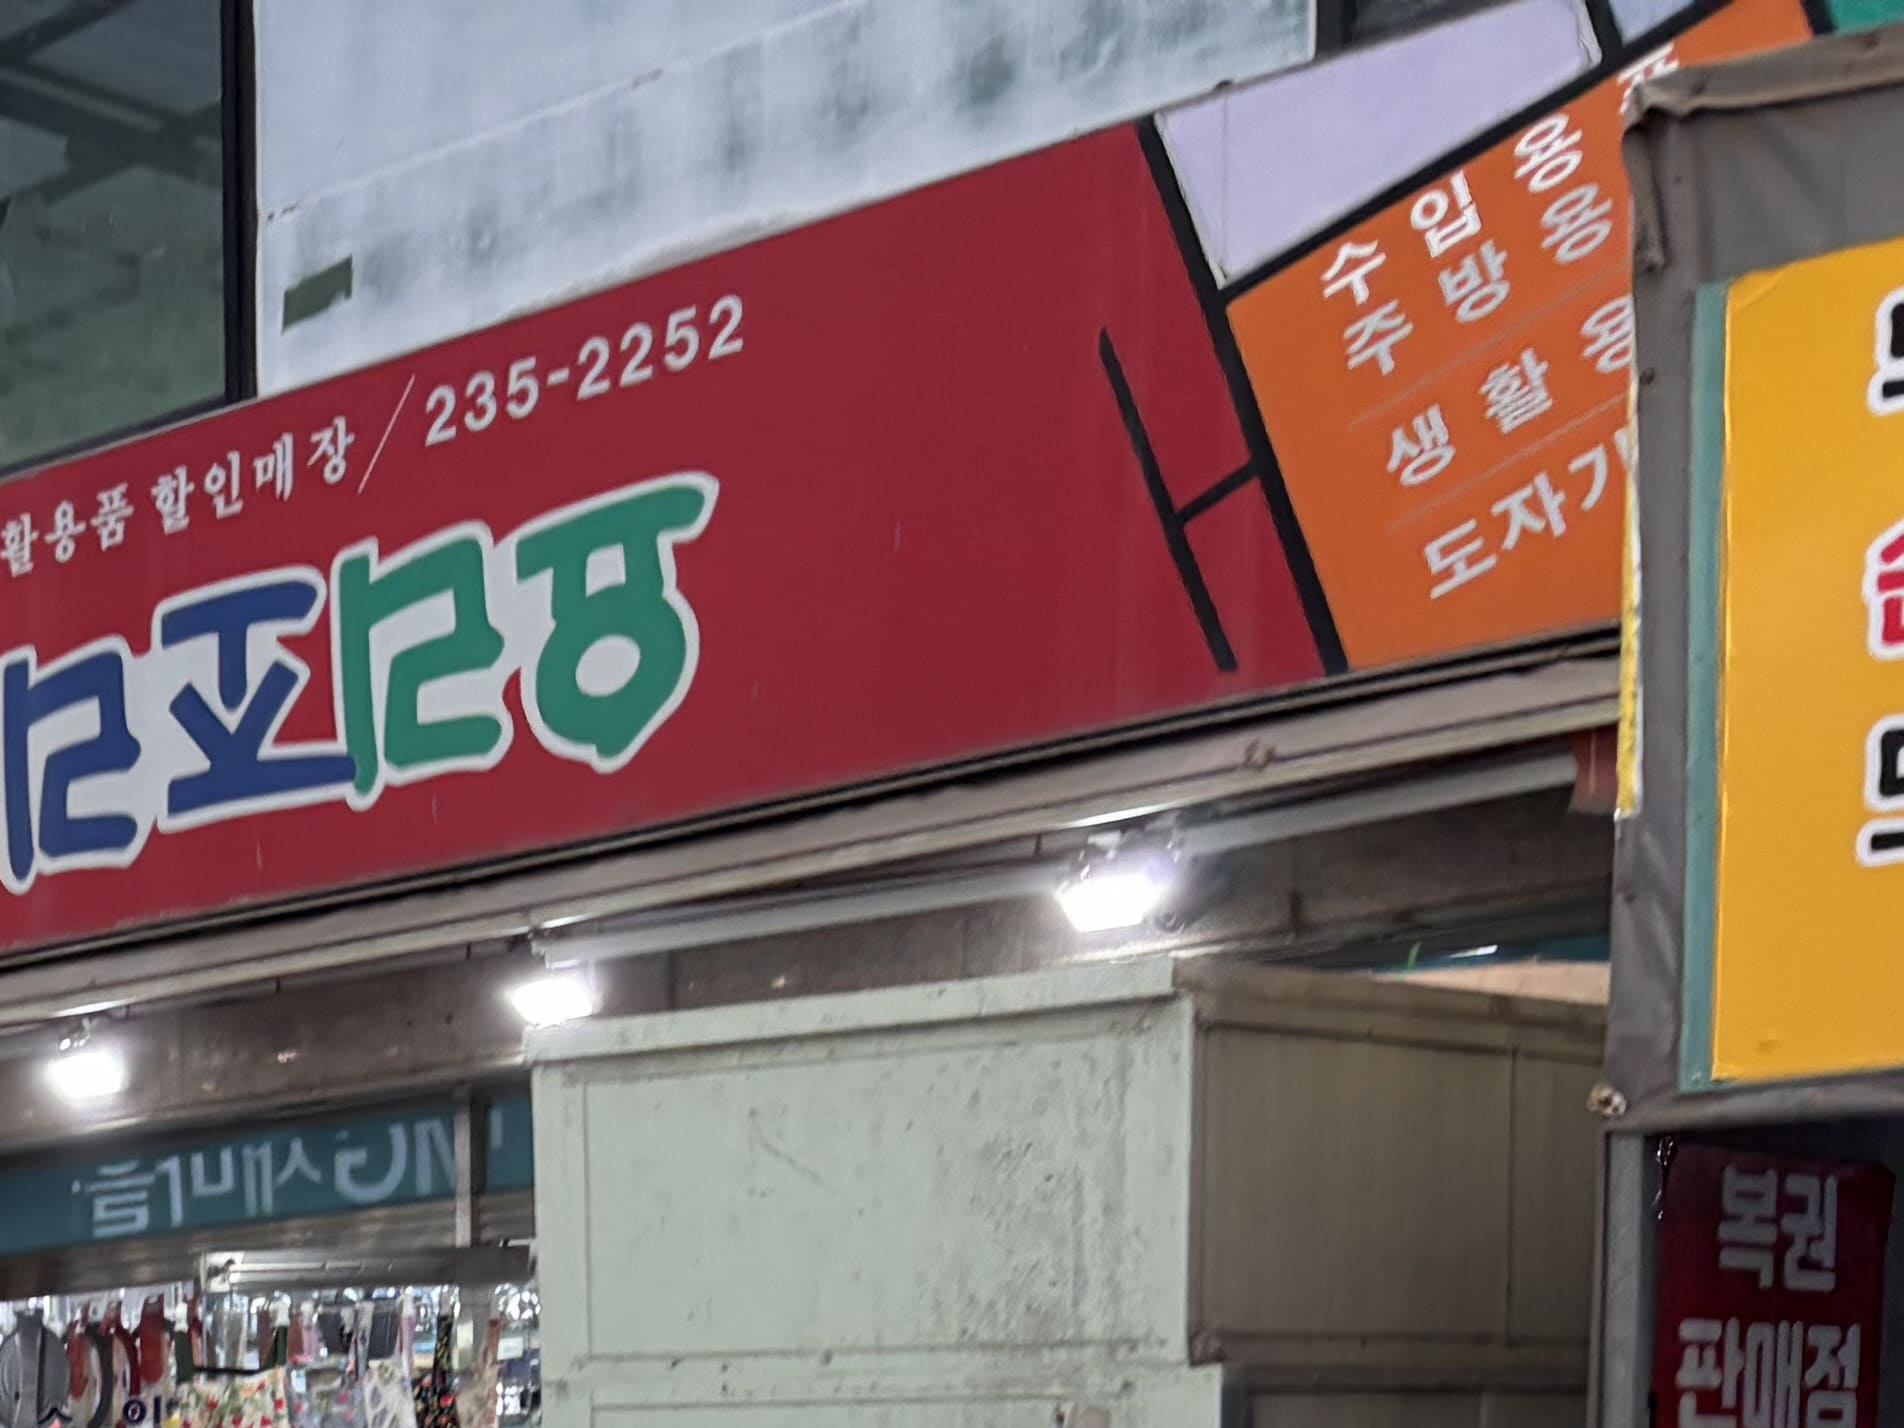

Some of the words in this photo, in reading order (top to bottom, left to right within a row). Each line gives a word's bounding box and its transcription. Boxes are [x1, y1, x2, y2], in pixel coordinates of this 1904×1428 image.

[151, 417, 354, 529] 할인매장
[425, 295, 745, 446] 235-2252
[1718, 1162, 1839, 1293] 복권
